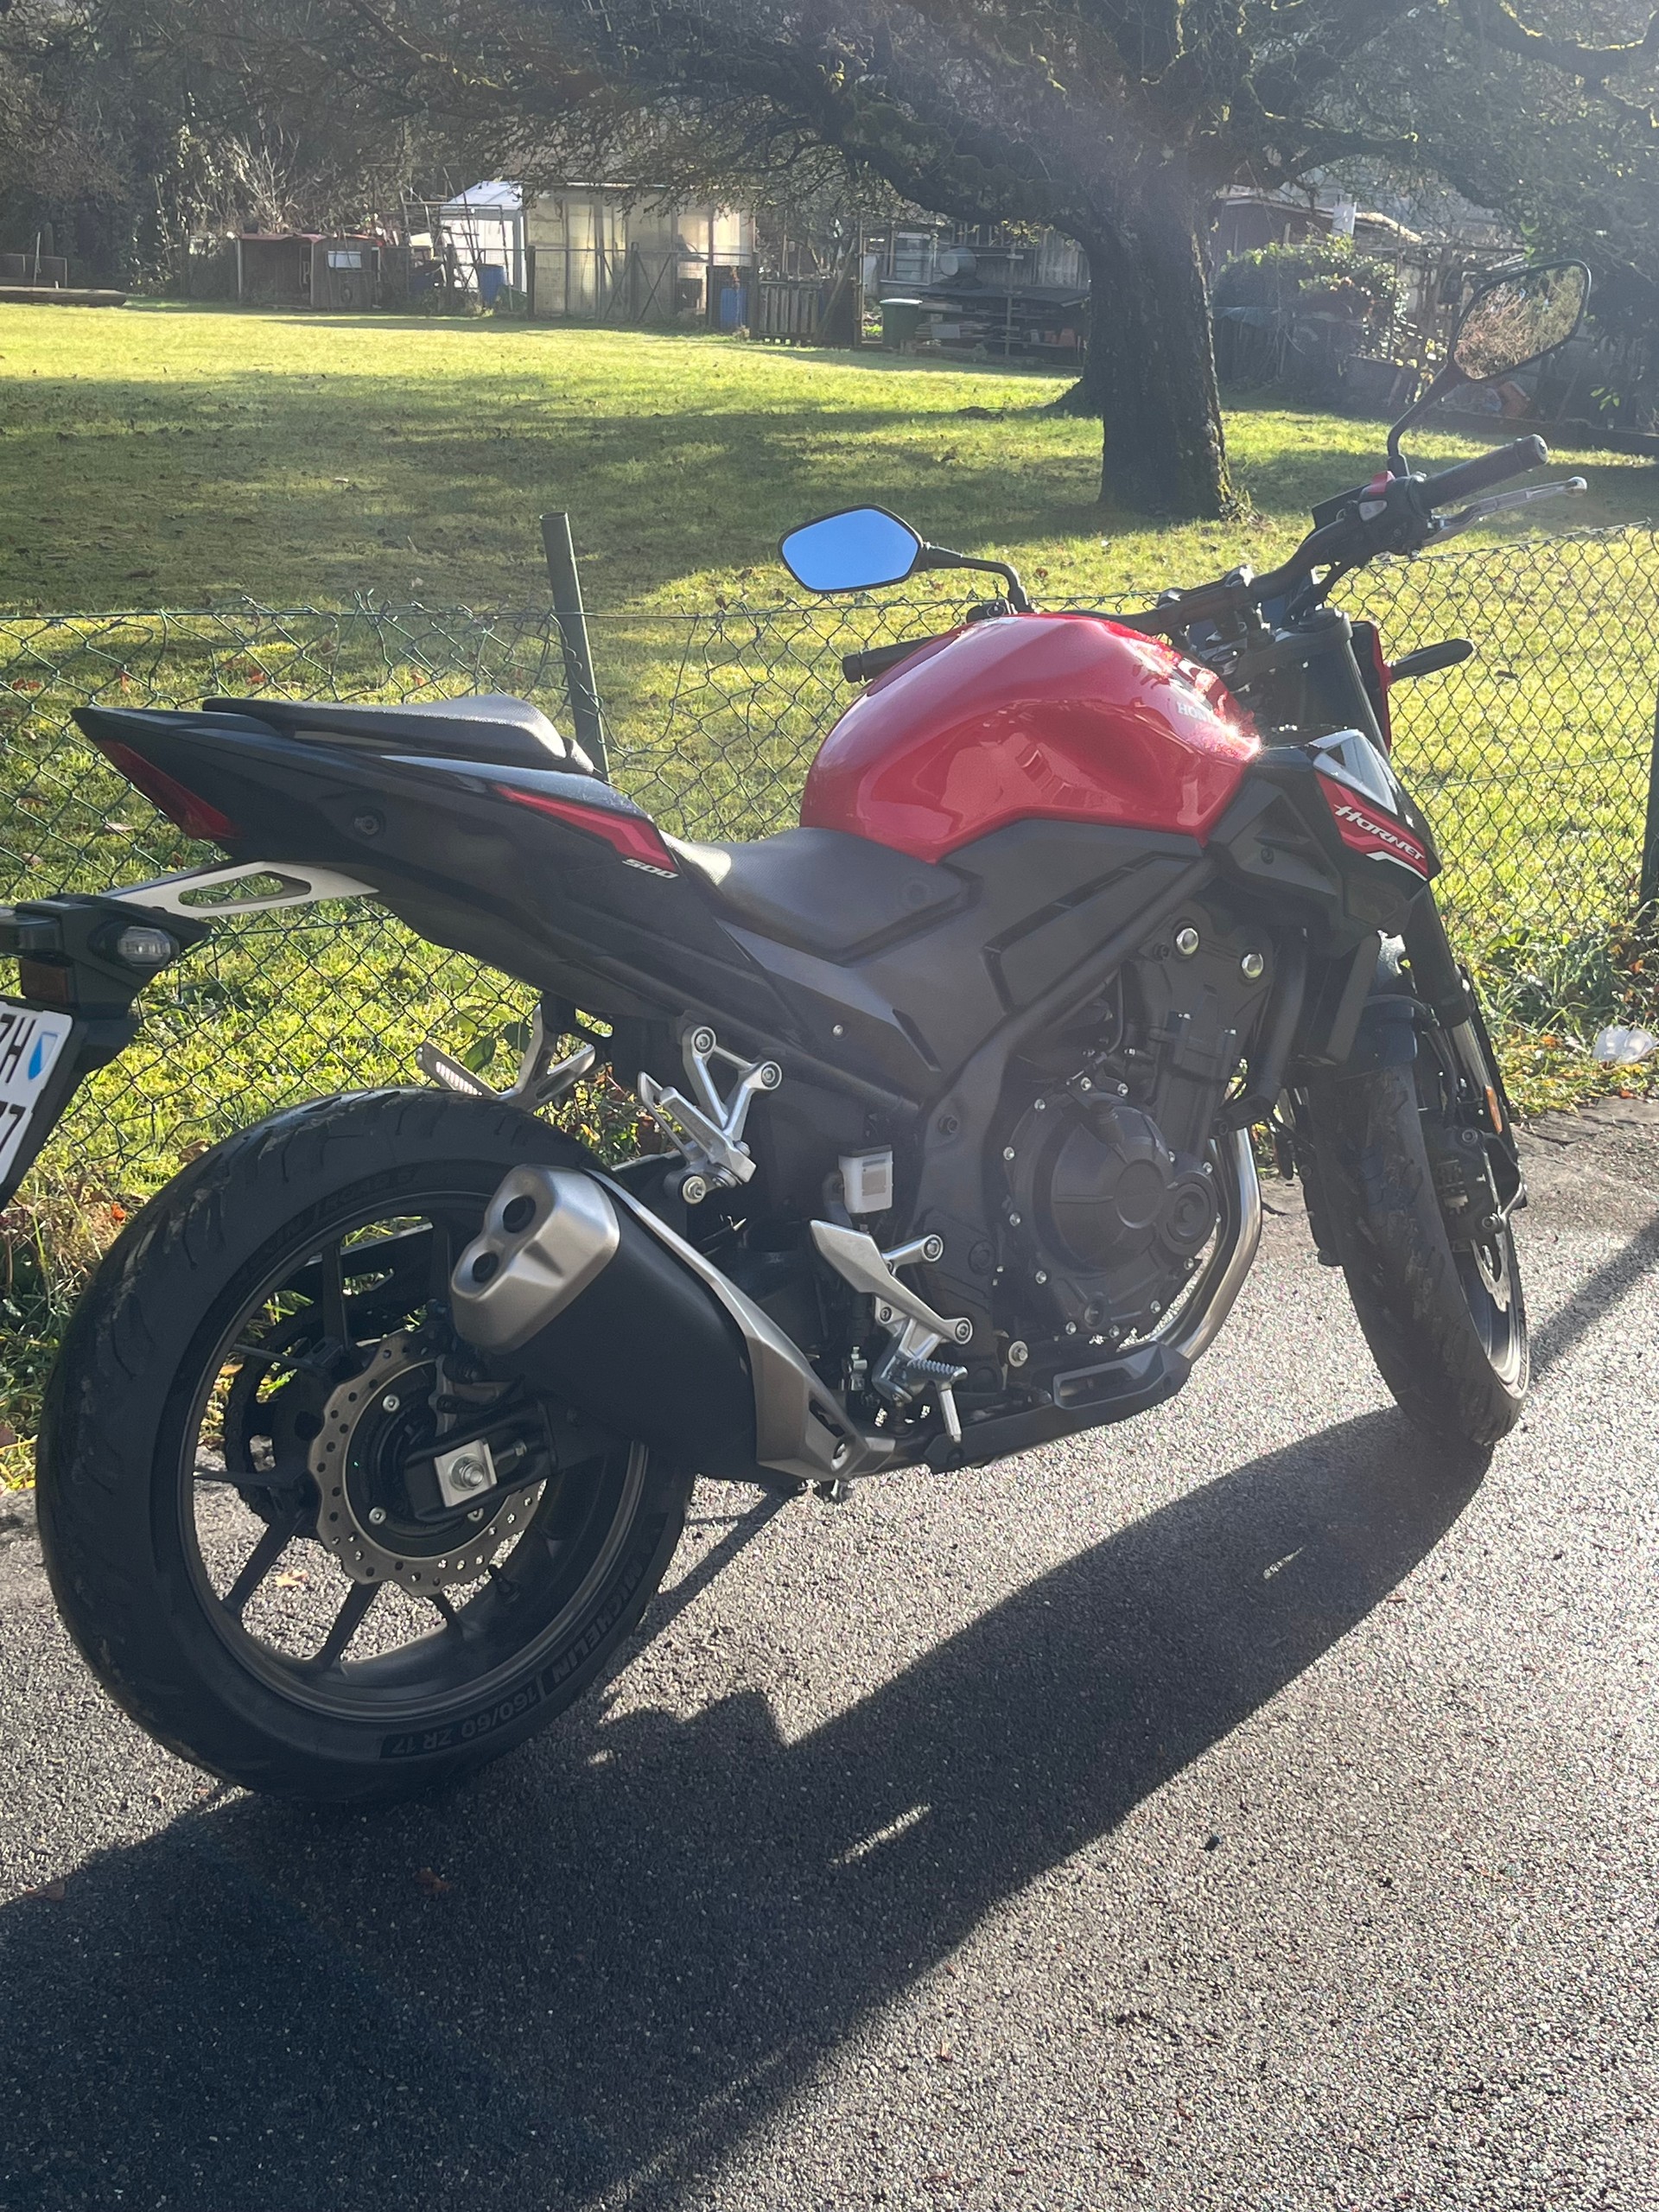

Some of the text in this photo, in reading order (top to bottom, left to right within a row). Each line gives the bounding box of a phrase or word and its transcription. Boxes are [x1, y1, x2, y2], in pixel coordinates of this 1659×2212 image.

[1333, 804, 1425, 860] HORNET
[622, 858, 679, 880] 500
[551, 1558, 645, 1684] MICHELIN
[461, 1687, 538, 1738] 160/60
